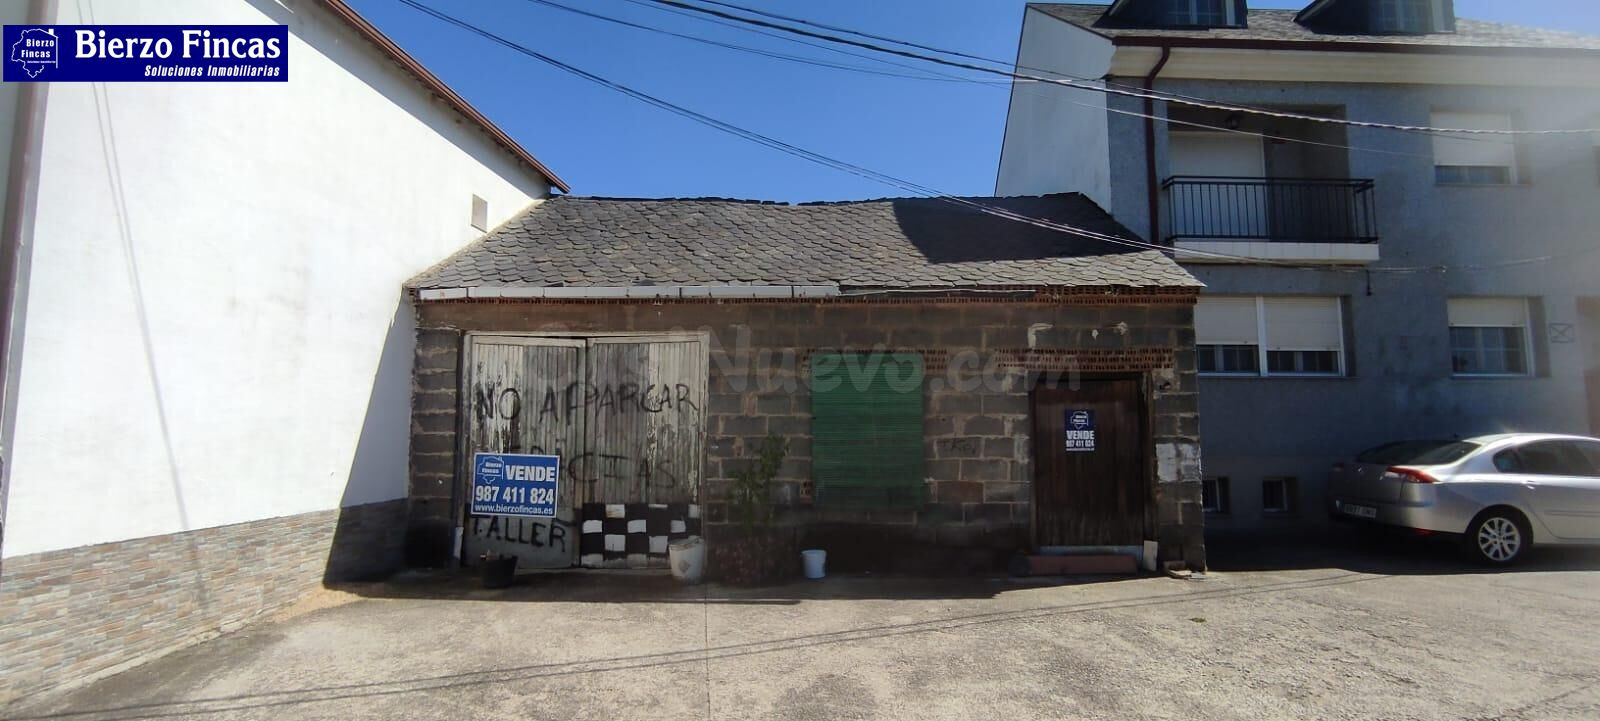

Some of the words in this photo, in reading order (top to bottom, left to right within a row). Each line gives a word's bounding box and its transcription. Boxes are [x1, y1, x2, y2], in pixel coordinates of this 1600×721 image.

[476, 384, 521, 420] NO
[1066, 430, 1095, 440] VENDE
[505, 465, 556, 482] VENDE
[475, 485, 499, 502] 987
[502, 486, 525, 503] 411
[530, 487, 554, 505] 824
[474, 504, 553, 515] www.bierzofincas.es
[470, 515, 566, 552] TALLER
